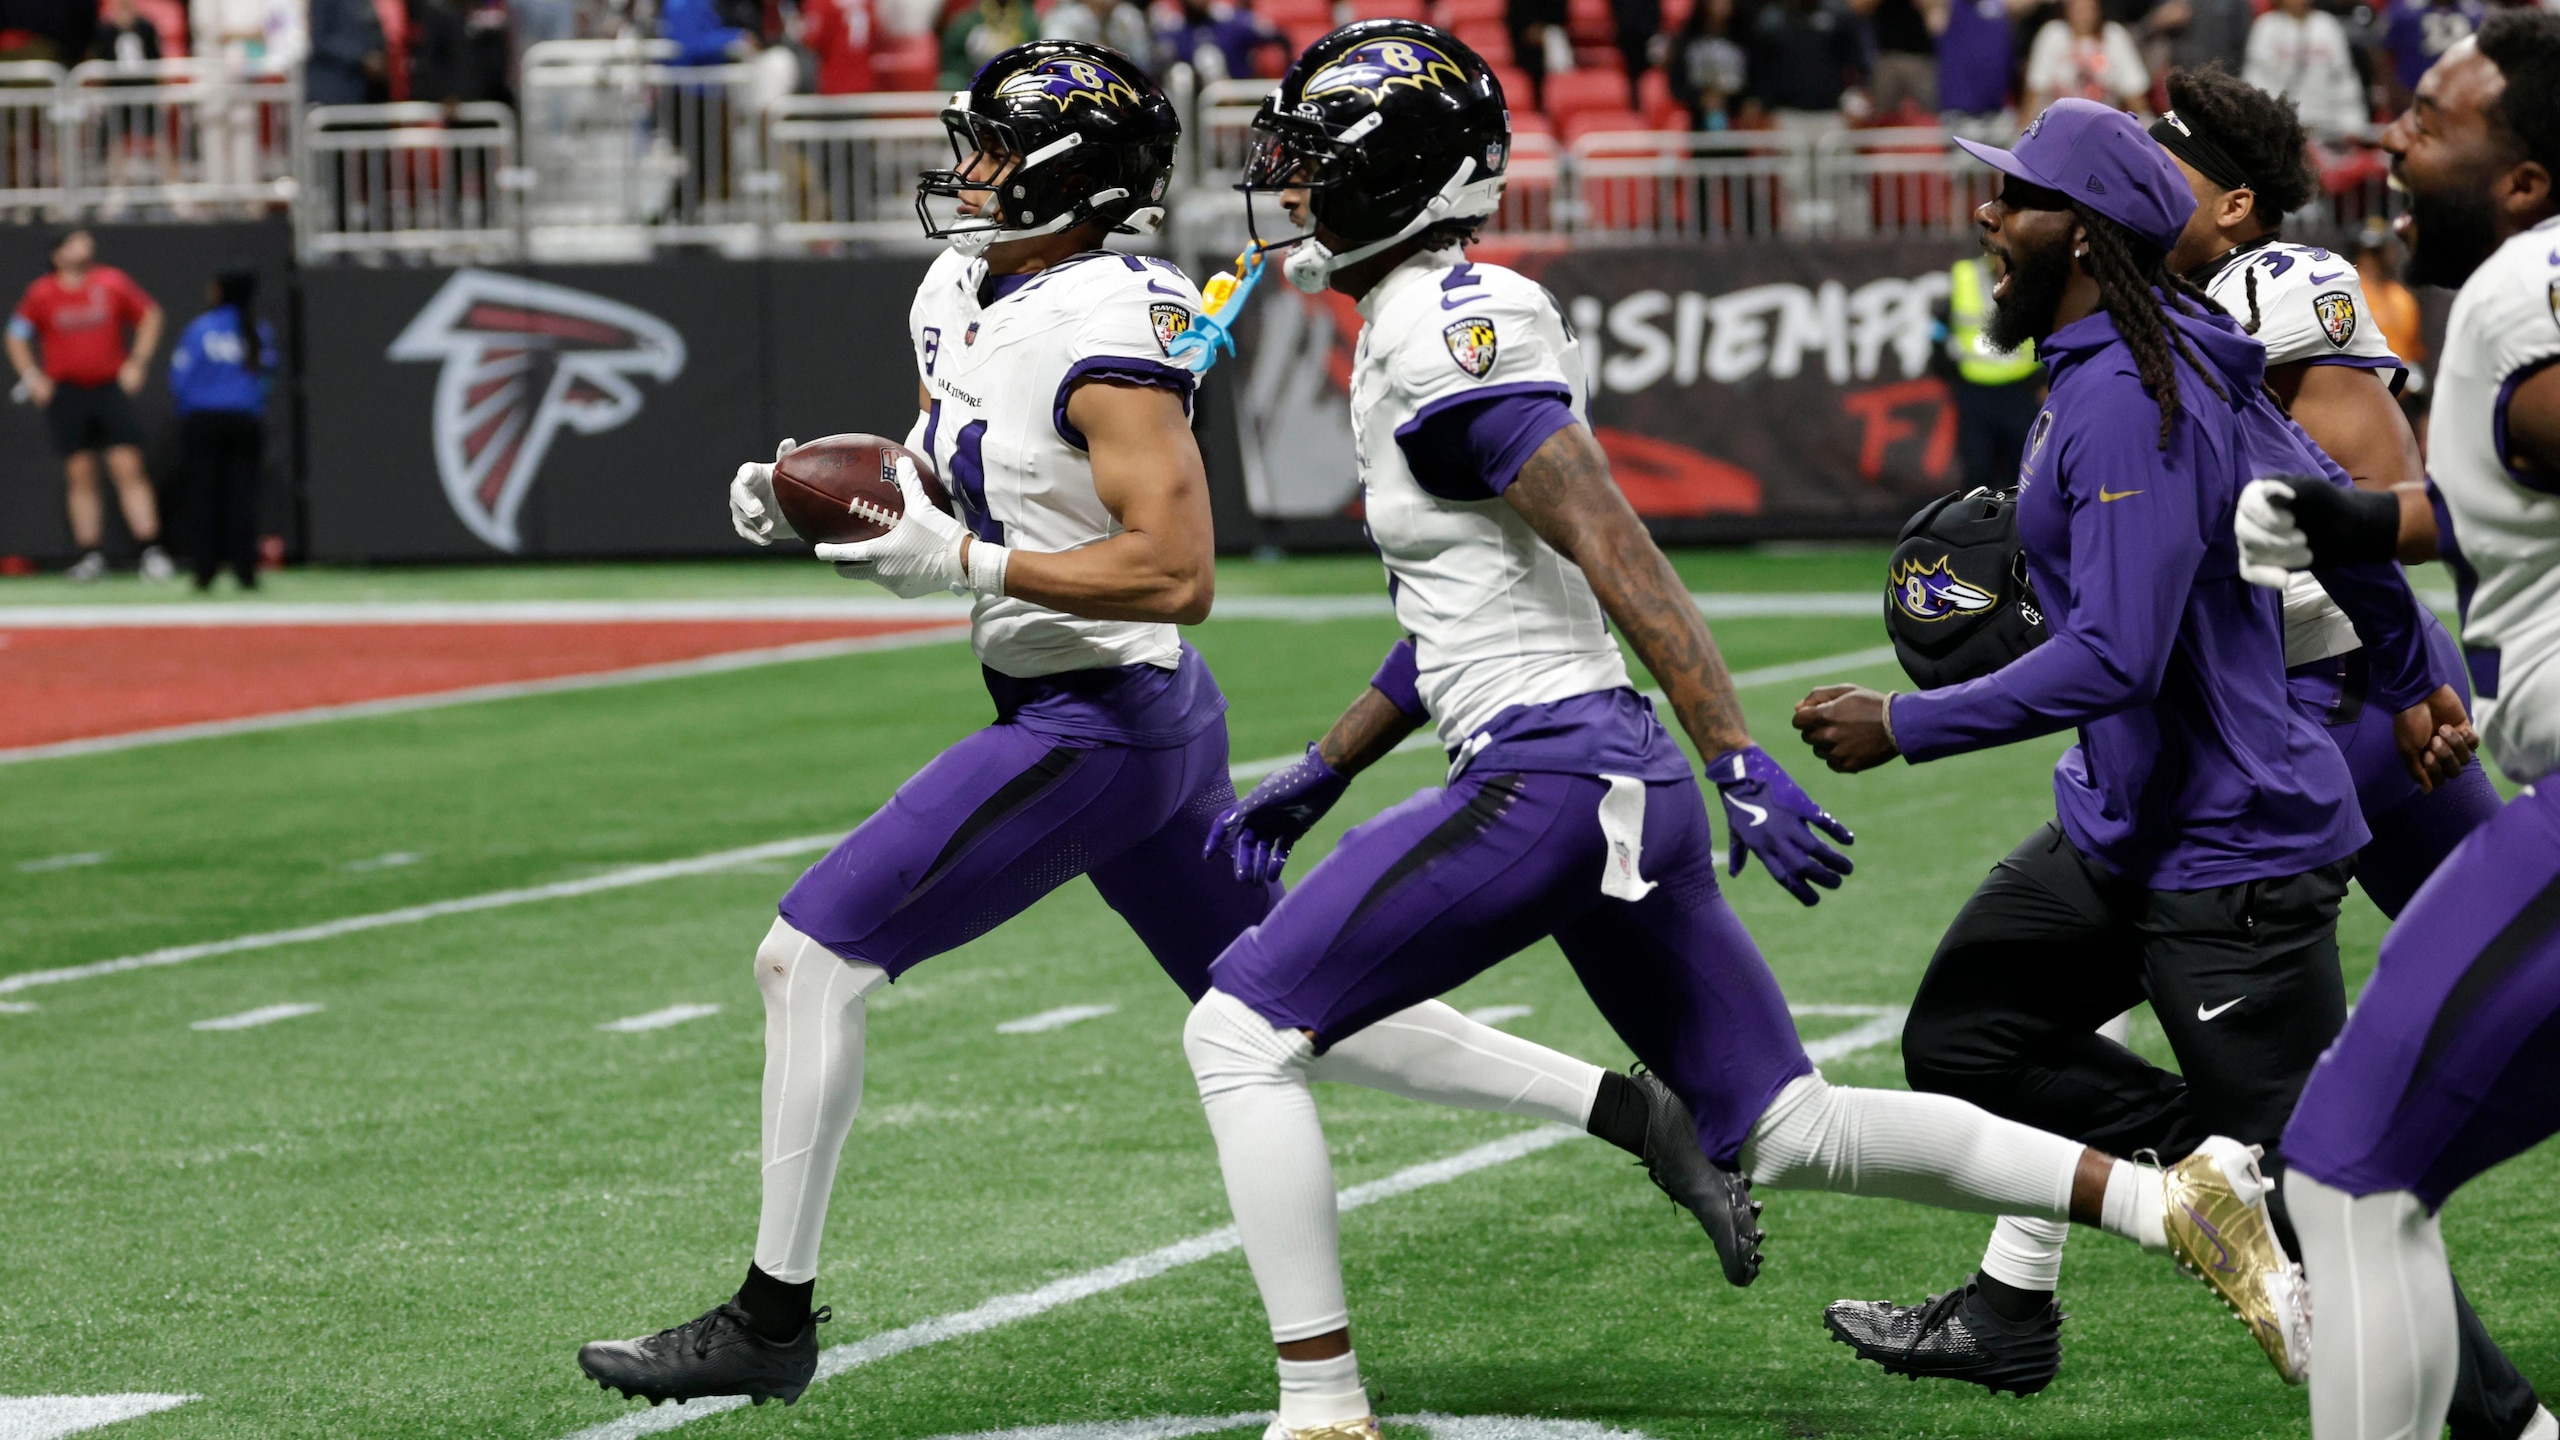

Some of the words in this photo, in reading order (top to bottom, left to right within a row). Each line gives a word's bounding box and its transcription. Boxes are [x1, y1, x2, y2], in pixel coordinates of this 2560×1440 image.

[2314, 293, 2350, 306] RAVENS
[1150, 304, 1188, 318] RAVENS
[1446, 319, 1491, 336] RAVENS
